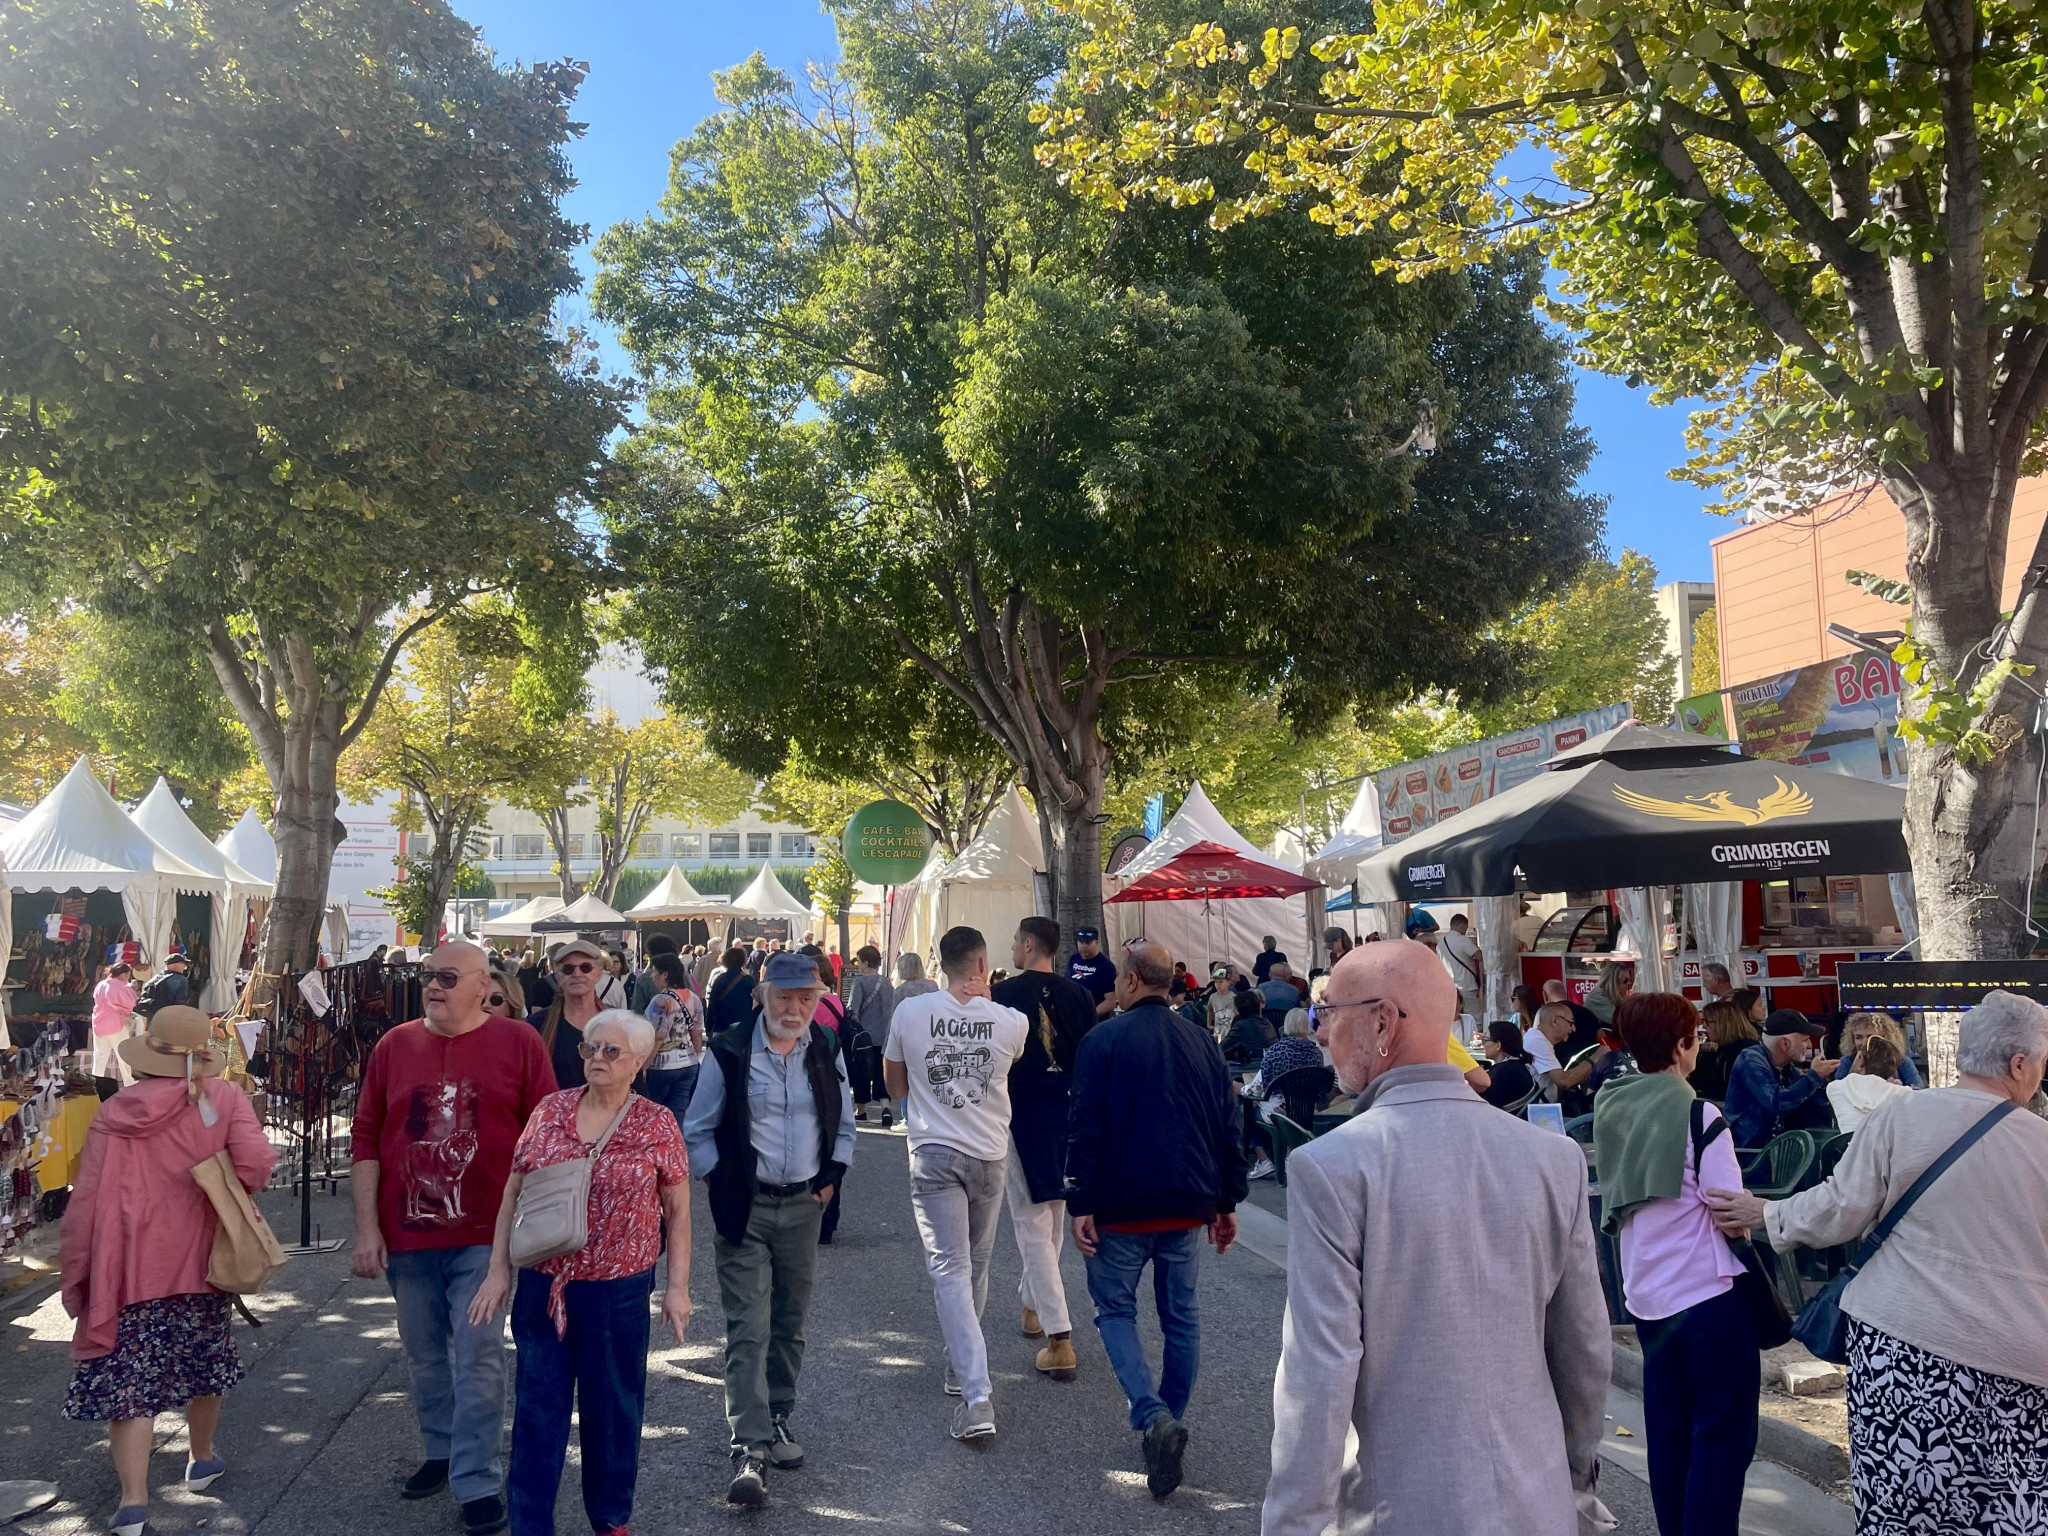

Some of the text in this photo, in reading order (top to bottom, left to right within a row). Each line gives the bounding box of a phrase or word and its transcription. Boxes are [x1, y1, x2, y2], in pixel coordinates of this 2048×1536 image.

[1737, 682, 1781, 704] COCKTAILS
[1758, 702, 1779, 714] MOJITO
[1560, 734, 1581, 746] PANINI
[1498, 740, 1539, 757] SANDWICH FROID
[1459, 761, 1480, 773] SANDWICH
[863, 824, 893, 835] CAFÉ
[904, 827, 924, 836] BAR
[1393, 820, 1409, 830] FRITES
[861, 837, 926, 848] COCKTAILS
[862, 849, 924, 859] L'ESCAPADE
[1711, 839, 1831, 863] GRIMBERGEN
[1116, 846, 1134, 871] ROSS
[1766, 859, 1782, 868] 1128
[1408, 863, 1446, 882] GRIMBERGEN
[1073, 963, 1097, 973] Reebok
[1575, 979, 1598, 994] CRÊP
